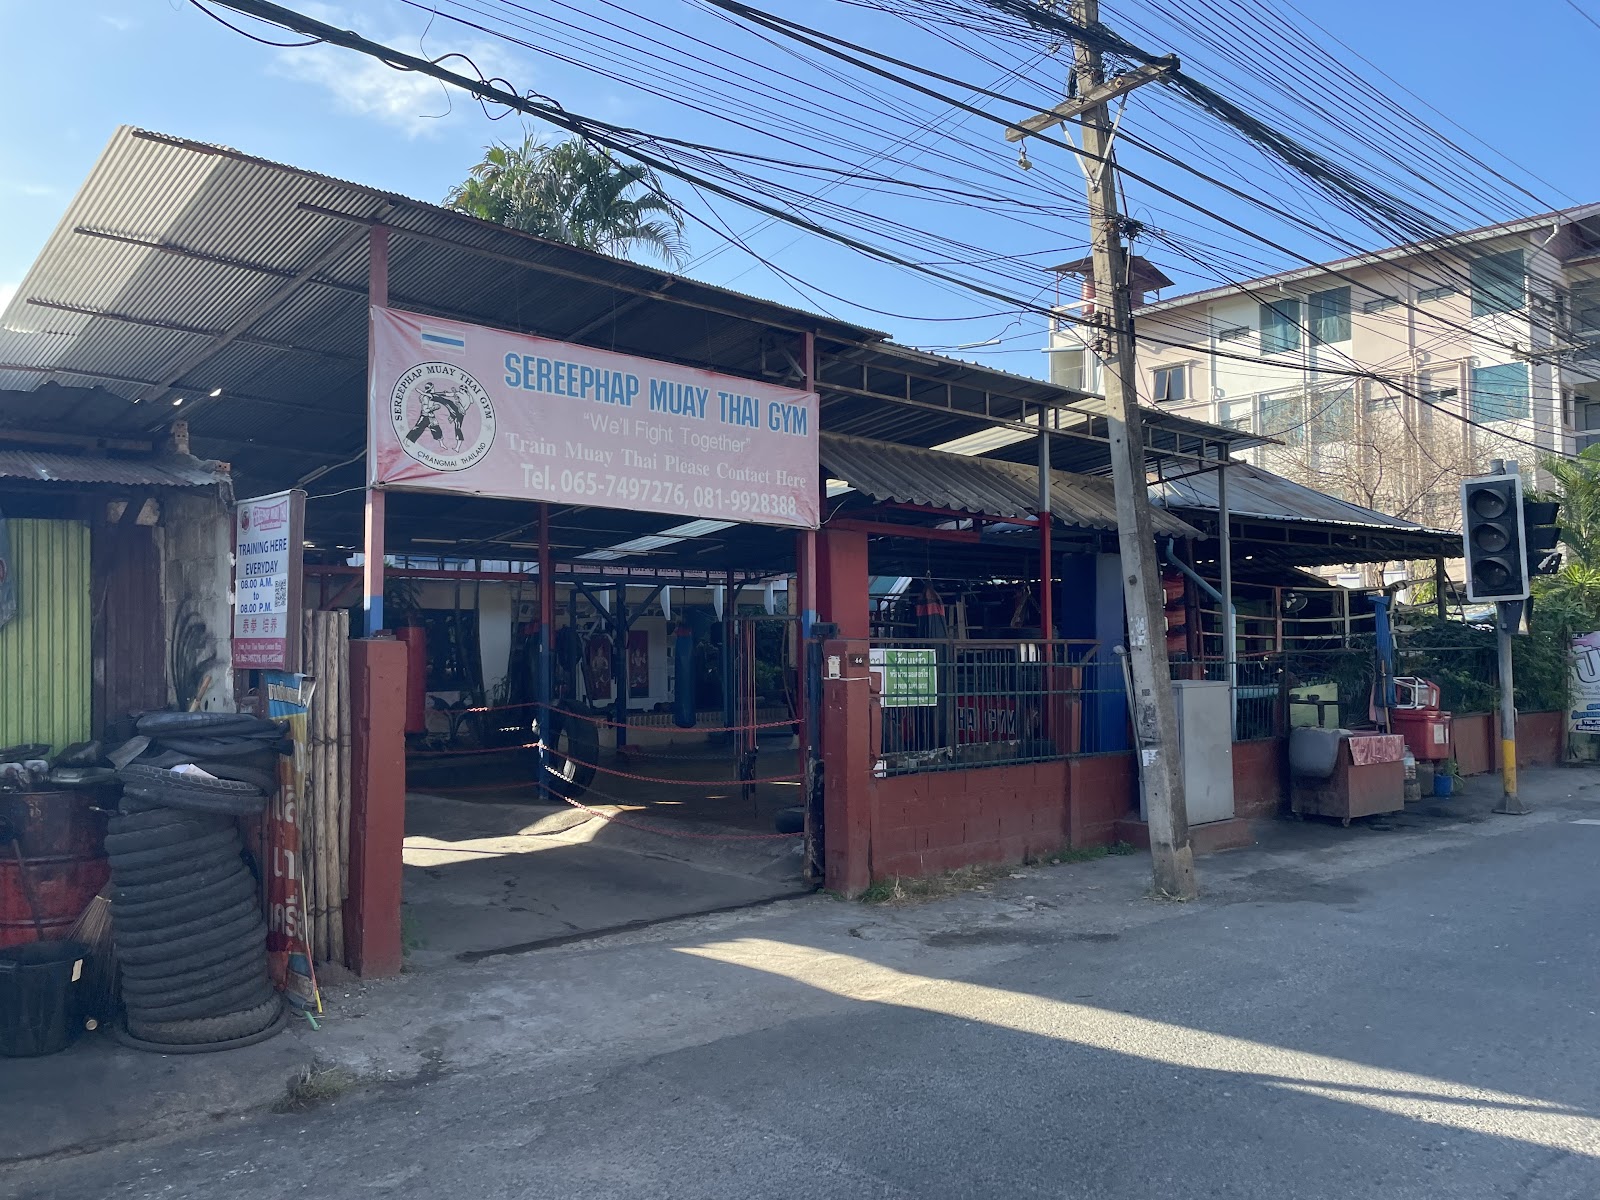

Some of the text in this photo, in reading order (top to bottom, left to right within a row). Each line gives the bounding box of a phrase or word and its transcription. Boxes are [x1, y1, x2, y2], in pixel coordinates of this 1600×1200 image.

[394, 366, 493, 421] SEREEPHAP MUAY THAI GYM
[504, 352, 808, 437] SEREEPHAP MUAY THAI GYM
[635, 420, 673, 445] Fight
[417, 442, 486, 467] CHIANGMAI THAILAND
[505, 432, 807, 488] Train Muay Thai Please Contact Here
[520, 463, 796, 516] Tel. 065-7497276, 081-9928388
[239, 537, 287, 556] TRAINING HERE
[245, 560, 279, 575] EVERYDAY
[241, 577, 273, 589] 08.00 A.M.
[253, 591, 259, 600] to
[240, 602, 272, 613] 08.00 P.M.
